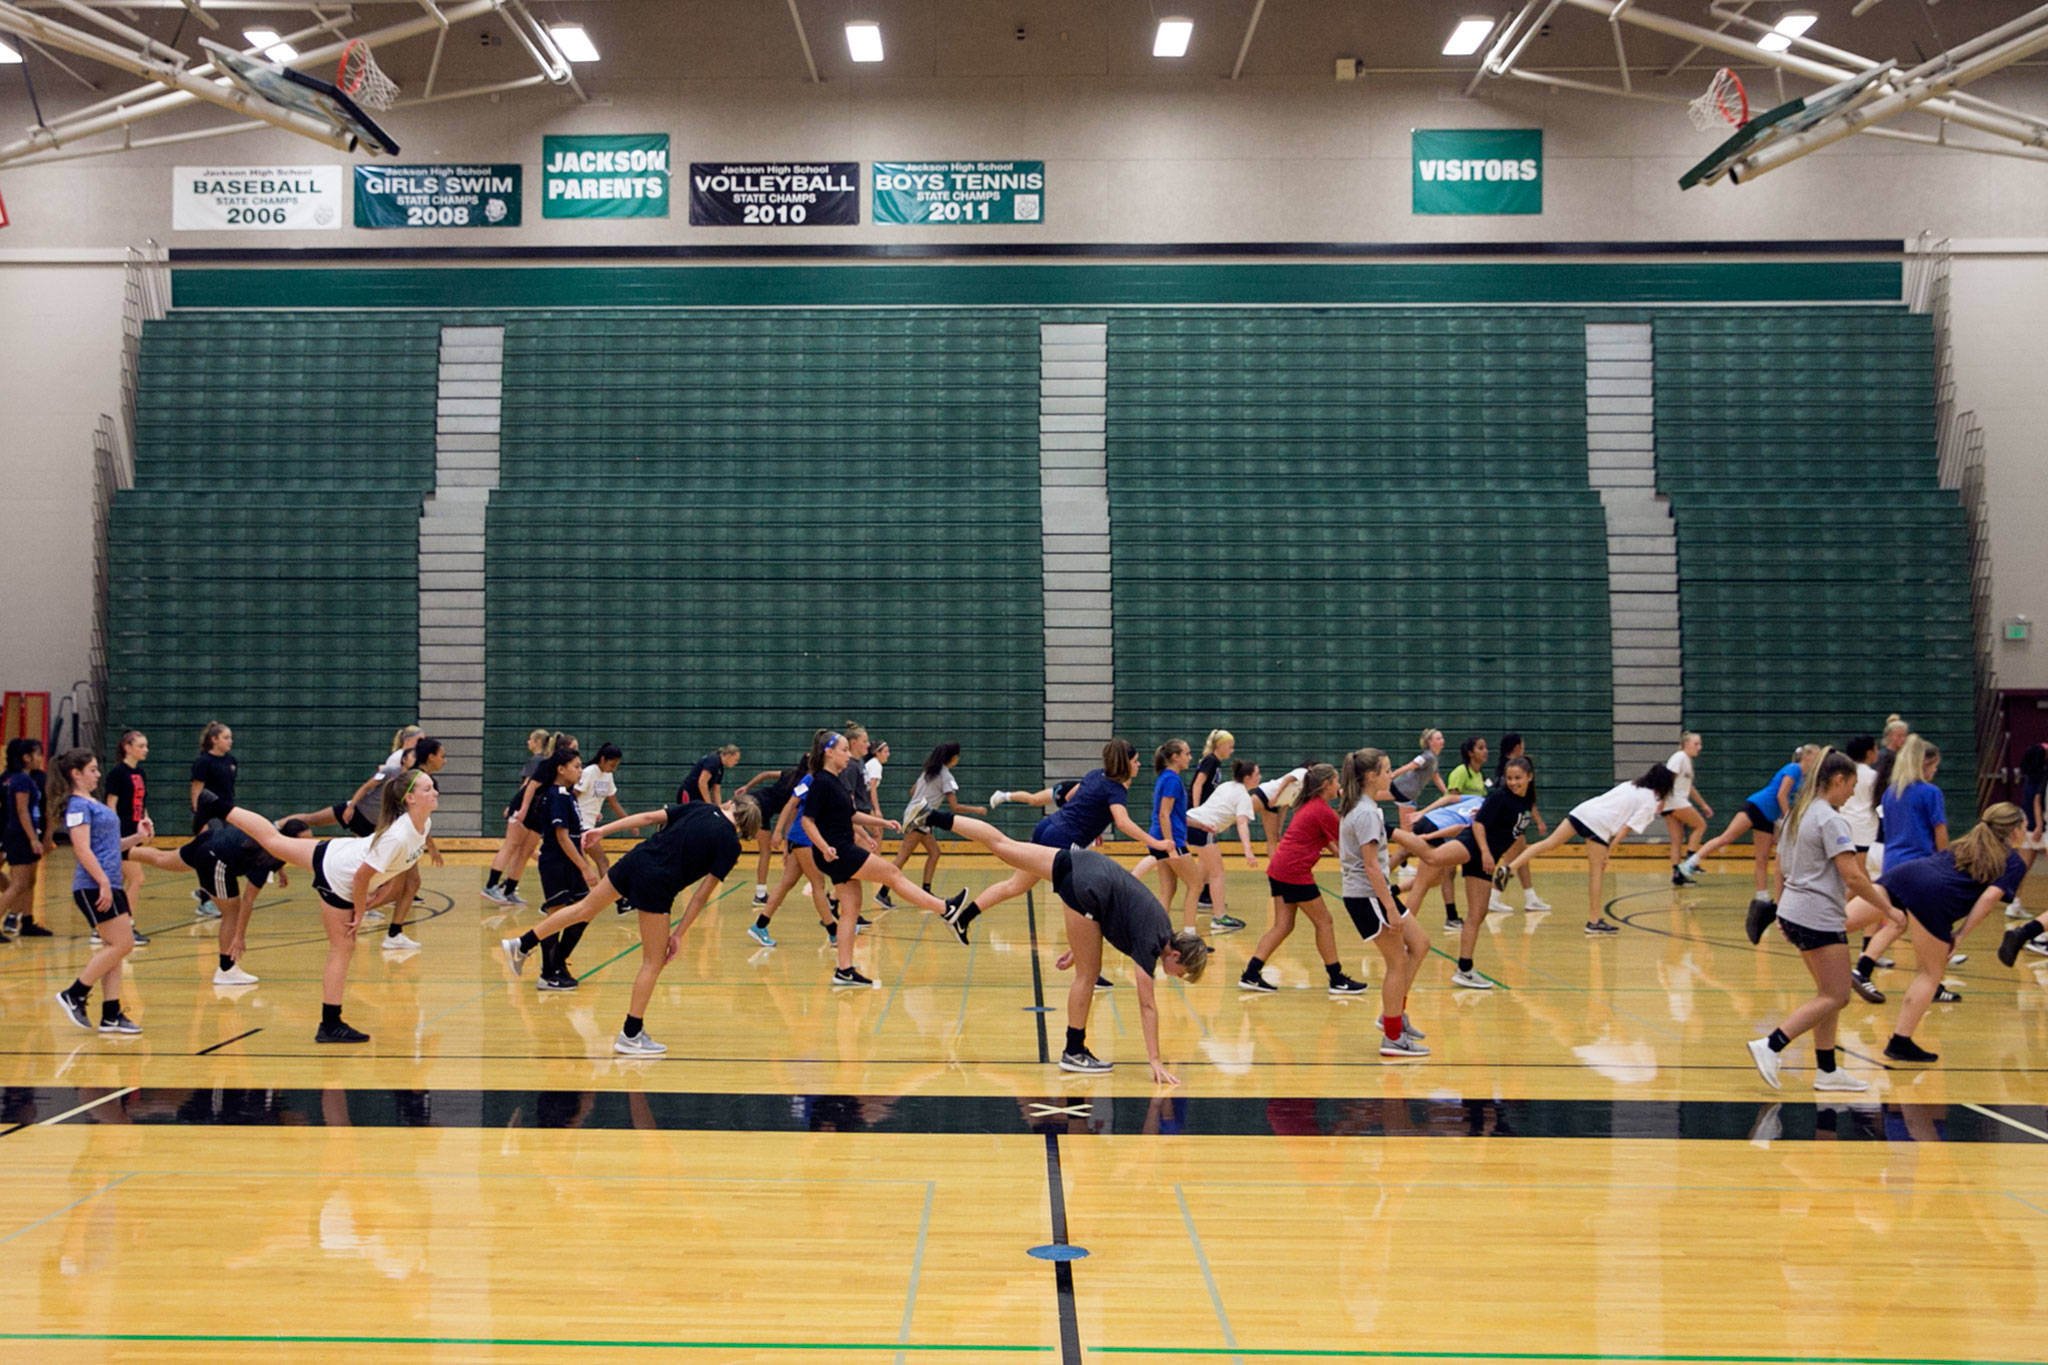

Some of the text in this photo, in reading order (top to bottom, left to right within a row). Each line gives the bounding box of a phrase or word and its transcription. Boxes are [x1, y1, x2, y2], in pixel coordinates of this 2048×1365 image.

[546, 149, 666, 173] JACKSON
[904, 163, 1013, 173] Jackson High School
[250, 169, 274, 177] High
[385, 167, 491, 177] Jackson High School
[721, 165, 829, 176] Jackson High School
[1419, 159, 1537, 181] VISITORS
[193, 180, 322, 194] BASEBALL
[365, 176, 513, 194] GIRLS SWIM
[548, 177, 663, 199] PARENTS
[695, 175, 855, 192] VOLLEYBALL
[875, 173, 1043, 191] BOYS TENNIS
[216, 197, 298, 205] STATE CHAMPS
[396, 195, 479, 205] STATE CHAMPS
[733, 193, 816, 203] STATE CHAMPS
[917, 191, 1000, 201] STATE CHAMPS
[227, 208, 286, 224] 2006
[407, 207, 469, 225] 2008
[743, 205, 806, 223] 2010
[929, 202, 989, 221] 2011
